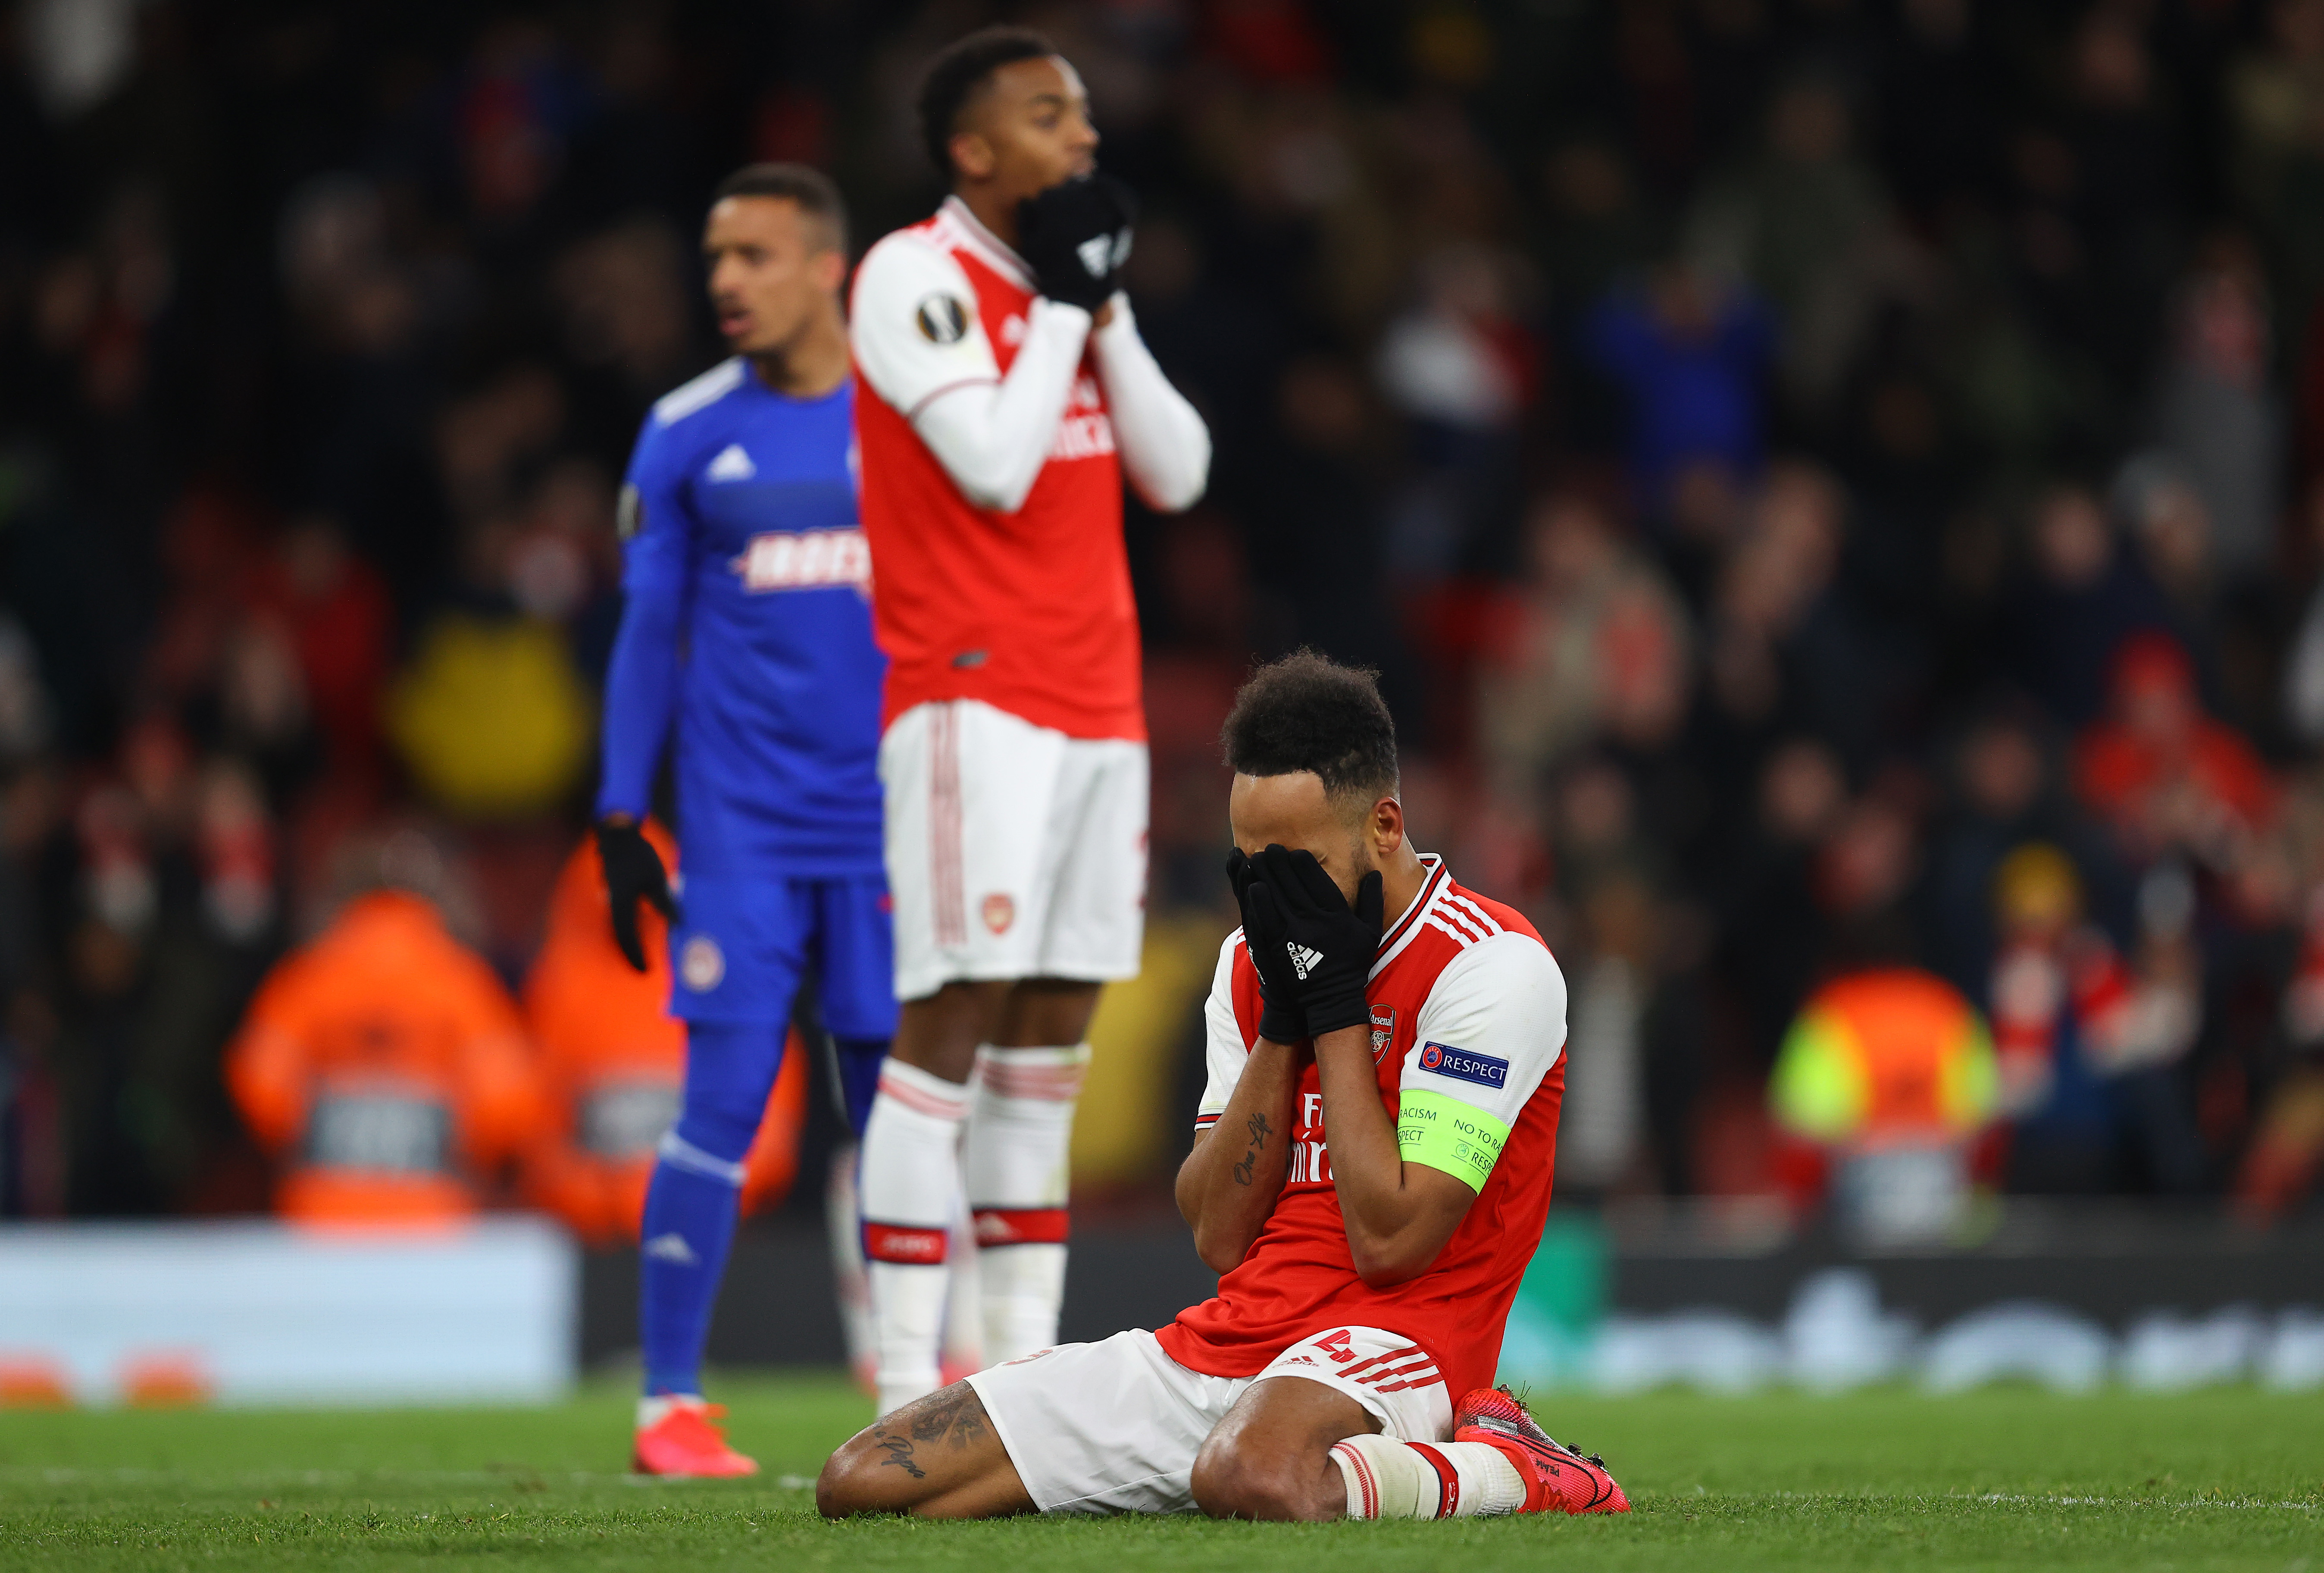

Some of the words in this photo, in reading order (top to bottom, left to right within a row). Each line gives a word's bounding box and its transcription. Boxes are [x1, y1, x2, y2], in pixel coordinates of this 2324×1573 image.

[1287, 941, 1307, 980] adidas
[1370, 1014, 1392, 1026] Arsenal
[1443, 1055, 1507, 1080] RESPECT
[1399, 1108, 1437, 1121] RACISM
[1397, 1130, 1424, 1143] SPECT
[1454, 1119, 1474, 1134] NO
[1477, 1128, 1491, 1144] TO
